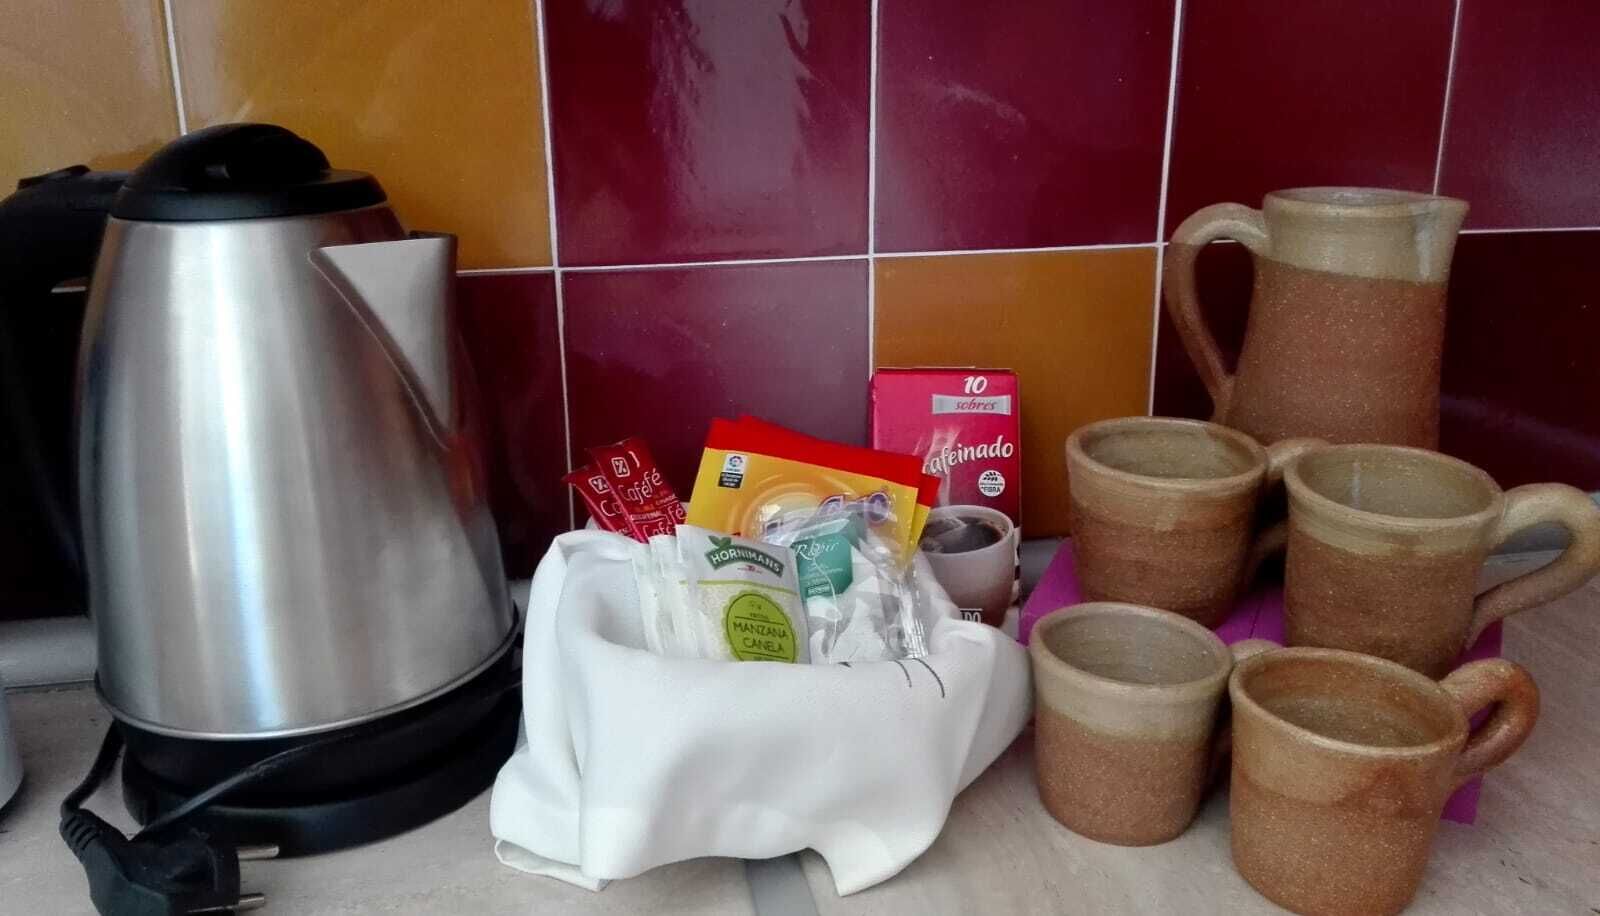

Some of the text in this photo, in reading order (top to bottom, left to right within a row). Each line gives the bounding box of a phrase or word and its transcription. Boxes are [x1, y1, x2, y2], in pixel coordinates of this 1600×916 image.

[964, 375, 988, 394] 10
[955, 398, 998, 411] sobres
[710, 548, 782, 574] HORNIMANS
[733, 621, 789, 639] MANZANA
[742, 637, 785, 653] CANELA
